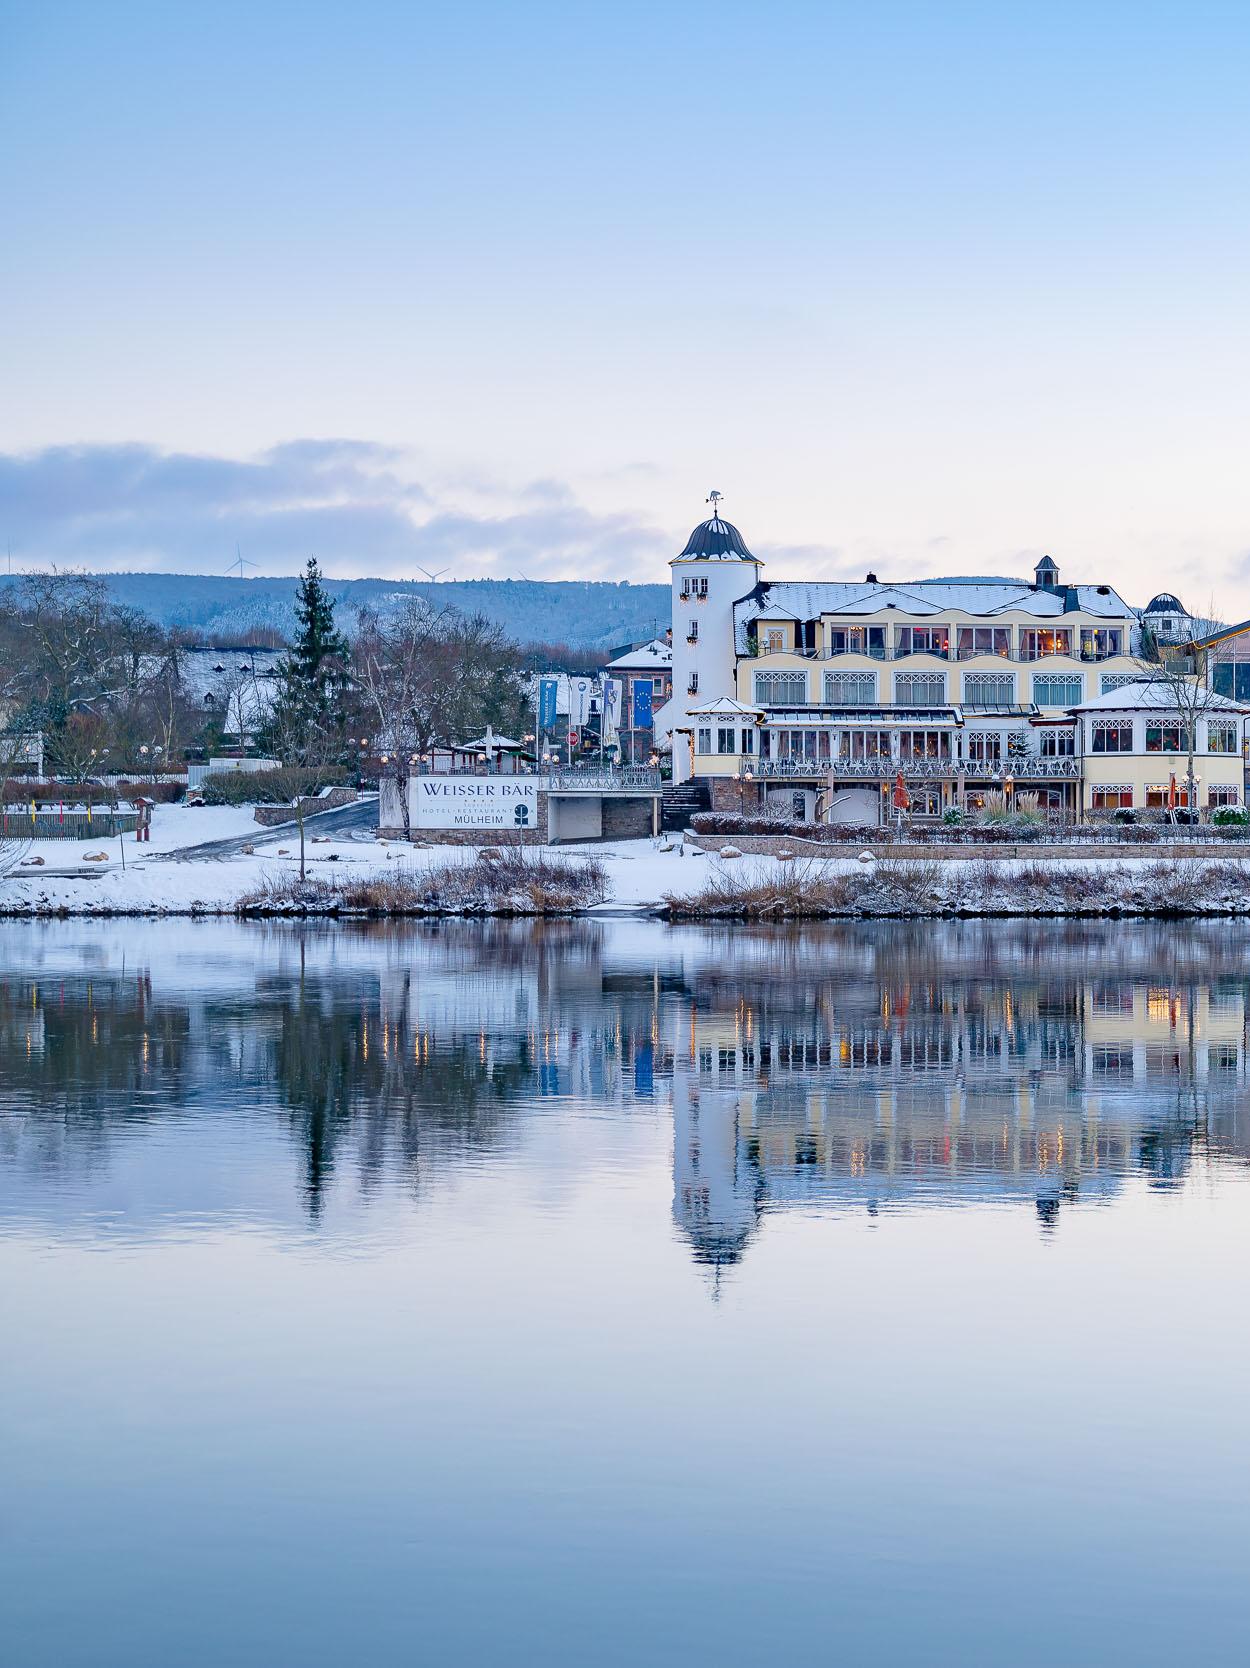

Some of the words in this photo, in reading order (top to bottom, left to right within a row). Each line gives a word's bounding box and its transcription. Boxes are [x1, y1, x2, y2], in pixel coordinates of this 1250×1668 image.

[424, 783, 495, 796] WEISSER
[502, 782, 534, 796] BÄR
[455, 815, 503, 824] MÜLHEIM
